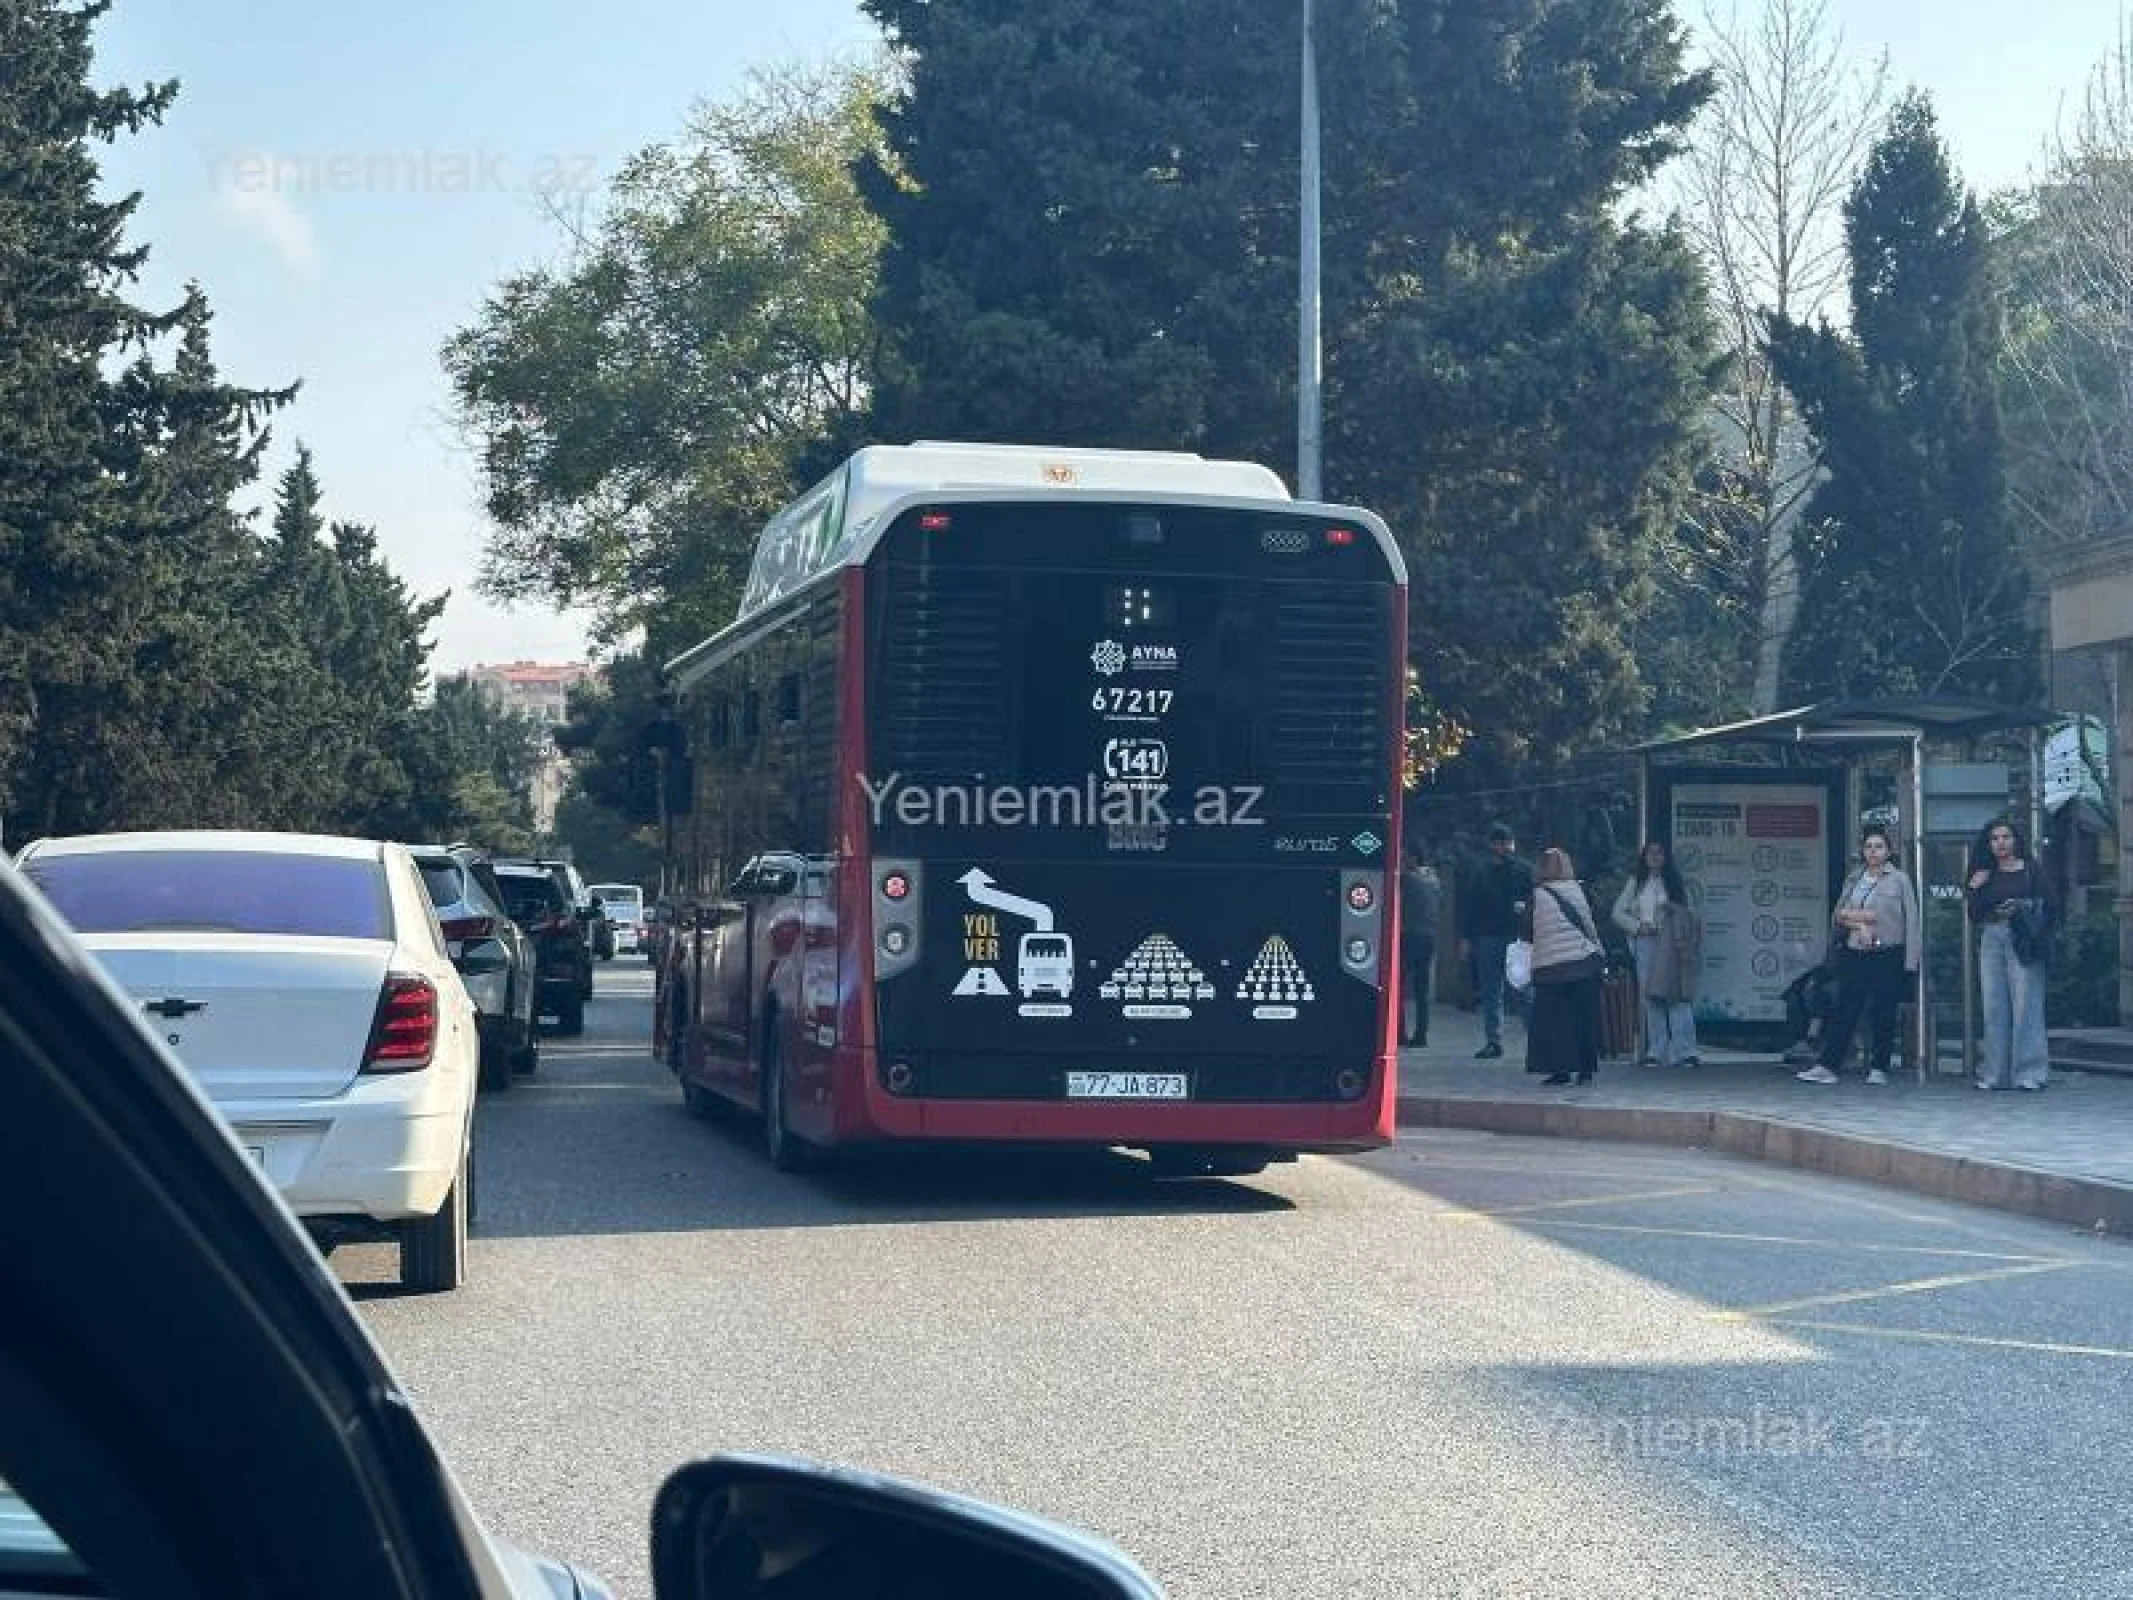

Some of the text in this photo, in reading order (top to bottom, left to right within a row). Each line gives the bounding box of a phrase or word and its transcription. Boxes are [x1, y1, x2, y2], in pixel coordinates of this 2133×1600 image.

[1132, 646, 1177, 660] AYNA
[1092, 687, 1174, 713] 67217
[1118, 749, 1160, 774] 141
[964, 914, 1000, 937] YOL
[964, 938, 1000, 961] VER
